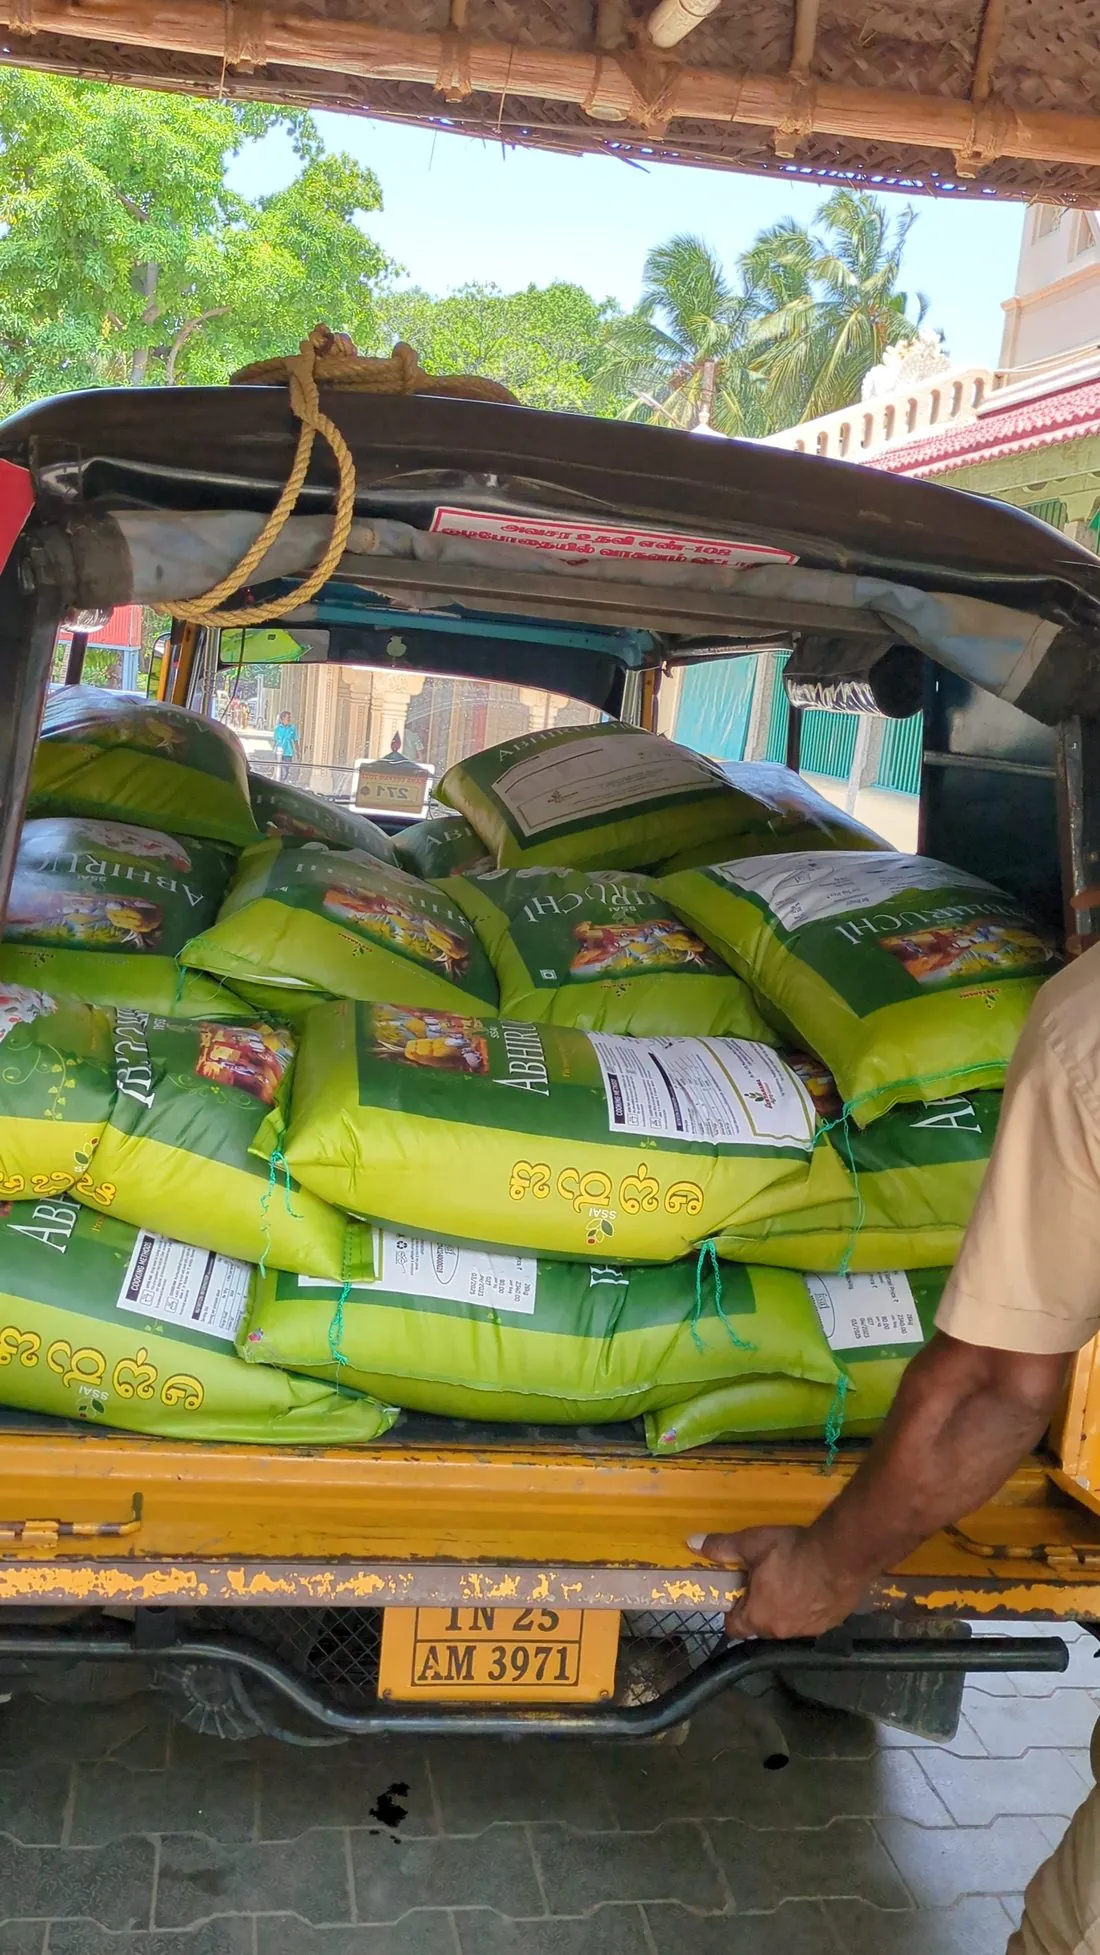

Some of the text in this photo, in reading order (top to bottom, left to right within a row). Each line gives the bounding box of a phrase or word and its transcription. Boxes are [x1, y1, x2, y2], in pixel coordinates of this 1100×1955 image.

[500, 524, 573, 540] அவசர
[576, 532, 635, 546] உதவி
[509, 1160, 704, 1217] ಅಭಿರುಚಿ
[588, 1207, 618, 1220] SSAI
[130, 1265, 145, 1292] COOKING
[78, 1384, 110, 1401] SSAI
[512, 1607, 560, 1632] 25
[417, 1644, 570, 1682] AM 3971
